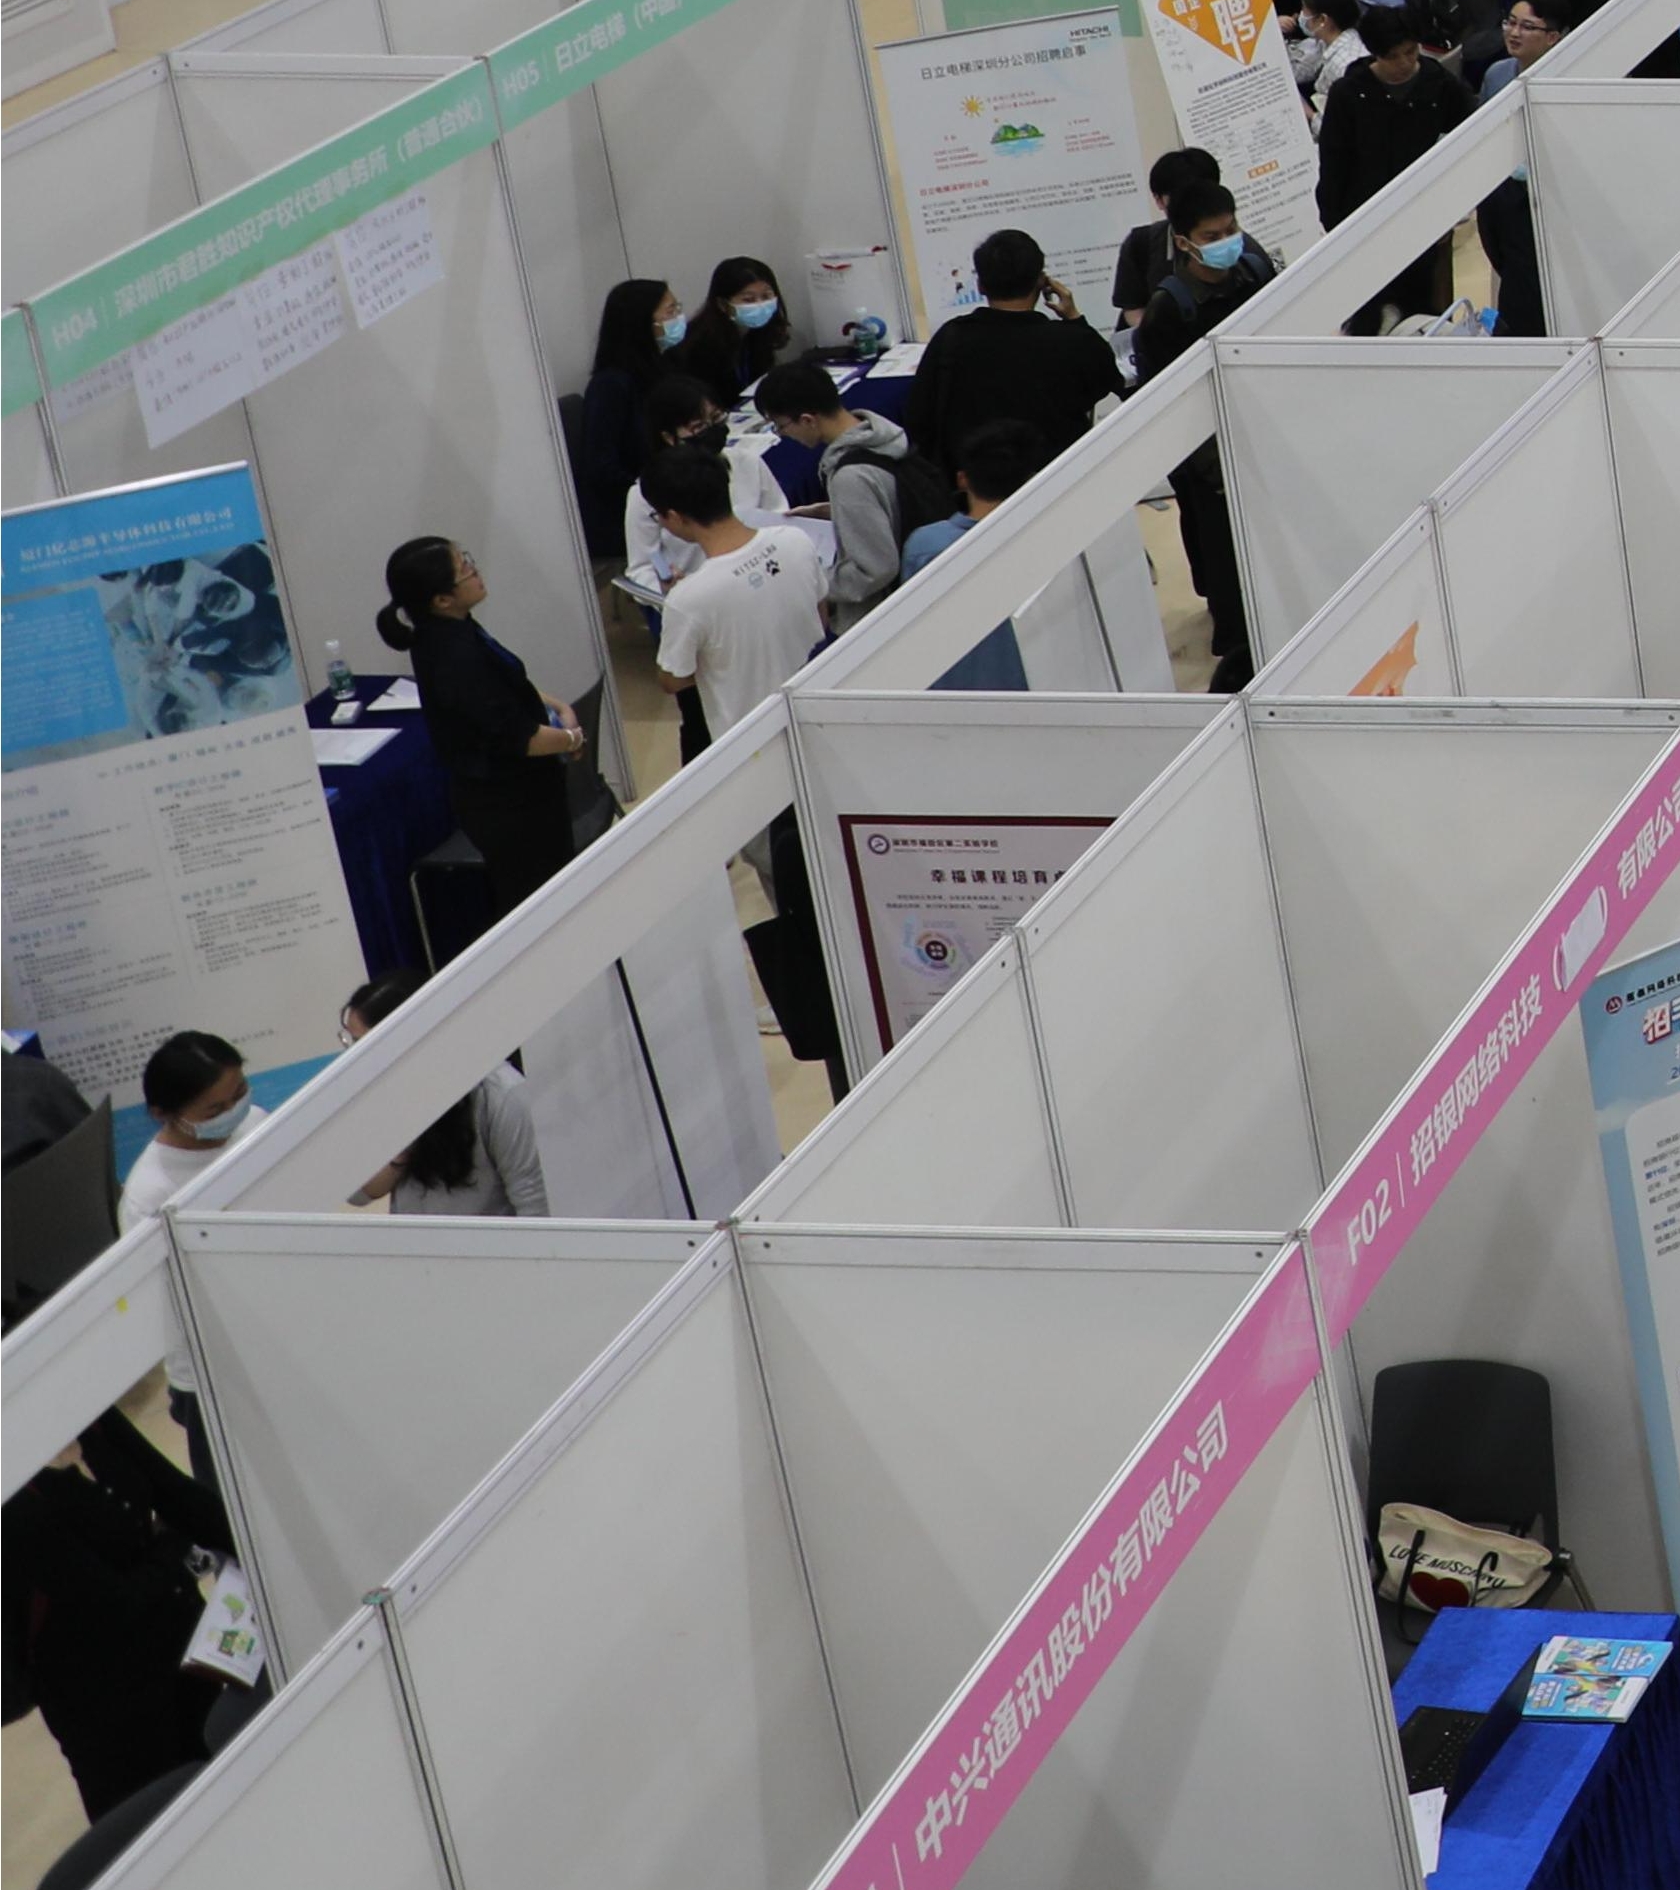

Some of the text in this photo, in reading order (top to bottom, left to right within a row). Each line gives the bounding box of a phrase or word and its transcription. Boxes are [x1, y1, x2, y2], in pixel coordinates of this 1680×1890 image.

[1069, 25, 1110, 39] HITACHI
[499, 54, 545, 103] H05
[920, 45, 1088, 80] 日立电梯深圳分公司招聘启事
[50, 305, 104, 354] H04
[1343, 1176, 1395, 1269] F02
[909, 1399, 1233, 1866] 中兴通讯股份有限公司
